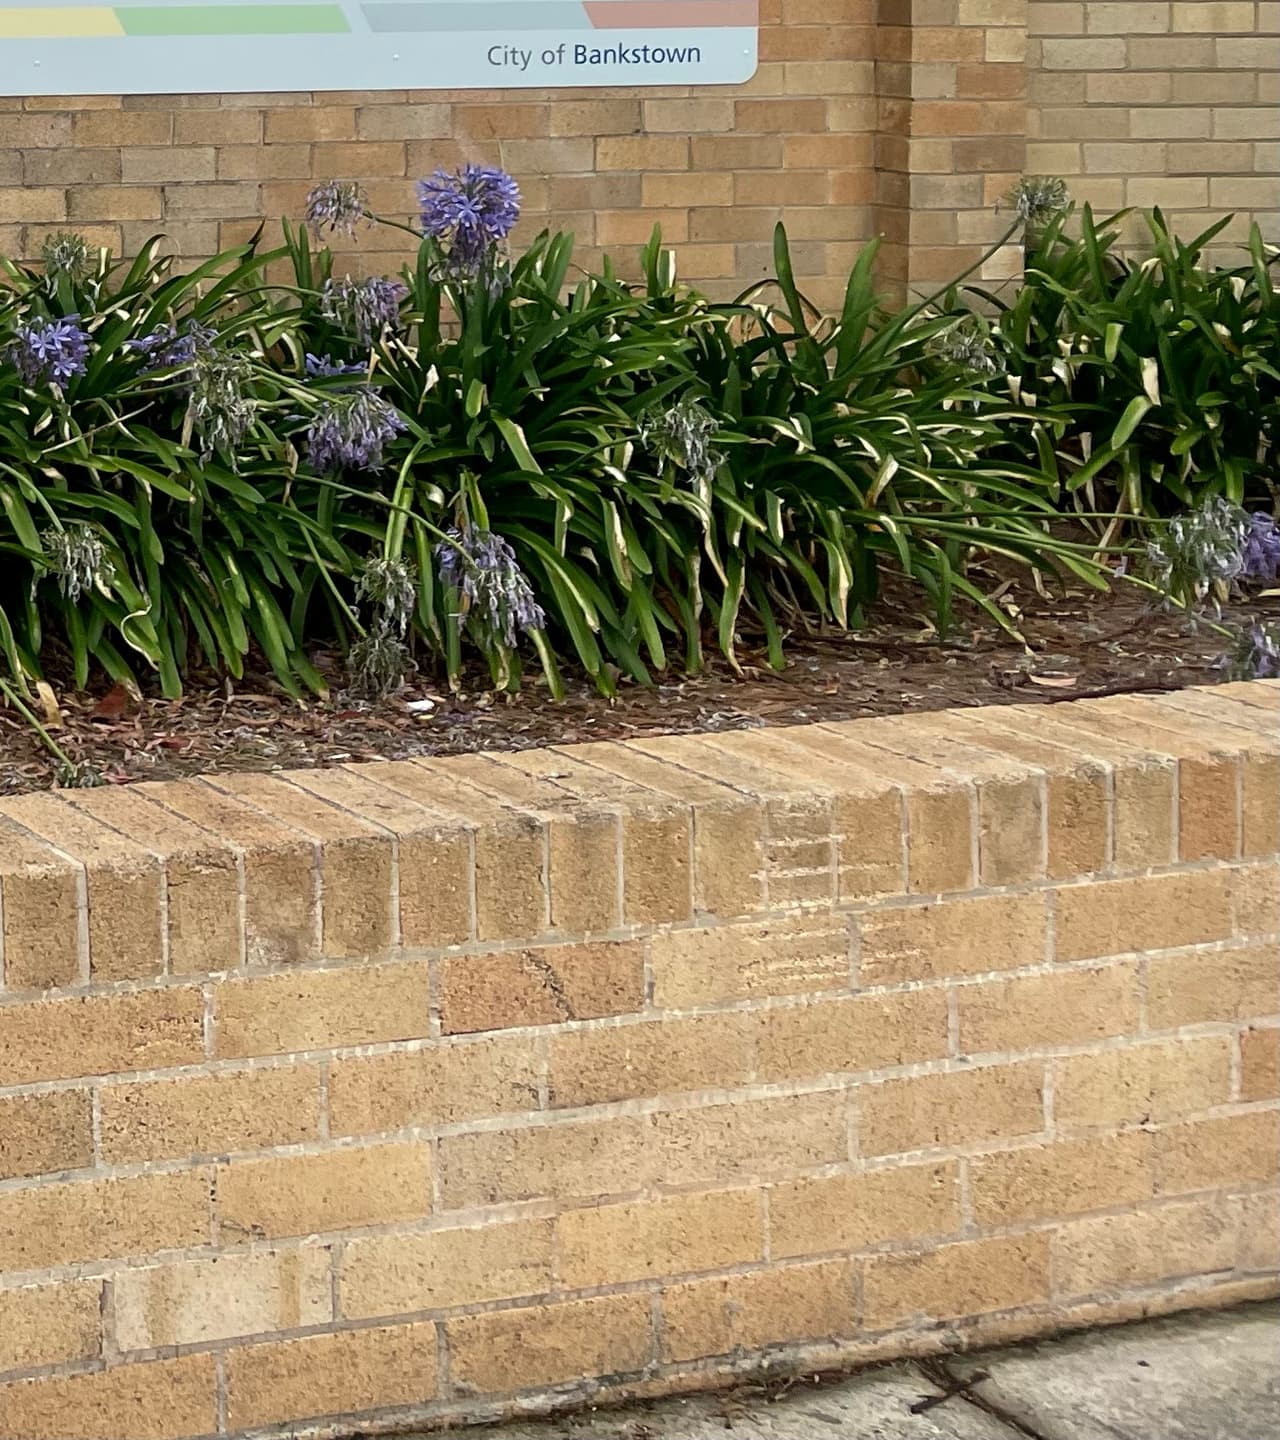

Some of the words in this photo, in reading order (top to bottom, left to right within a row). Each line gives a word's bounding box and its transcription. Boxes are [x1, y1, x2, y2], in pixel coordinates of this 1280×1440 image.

[487, 44, 533, 71] City
[540, 42, 567, 66] of
[574, 41, 701, 65] Bankstown
